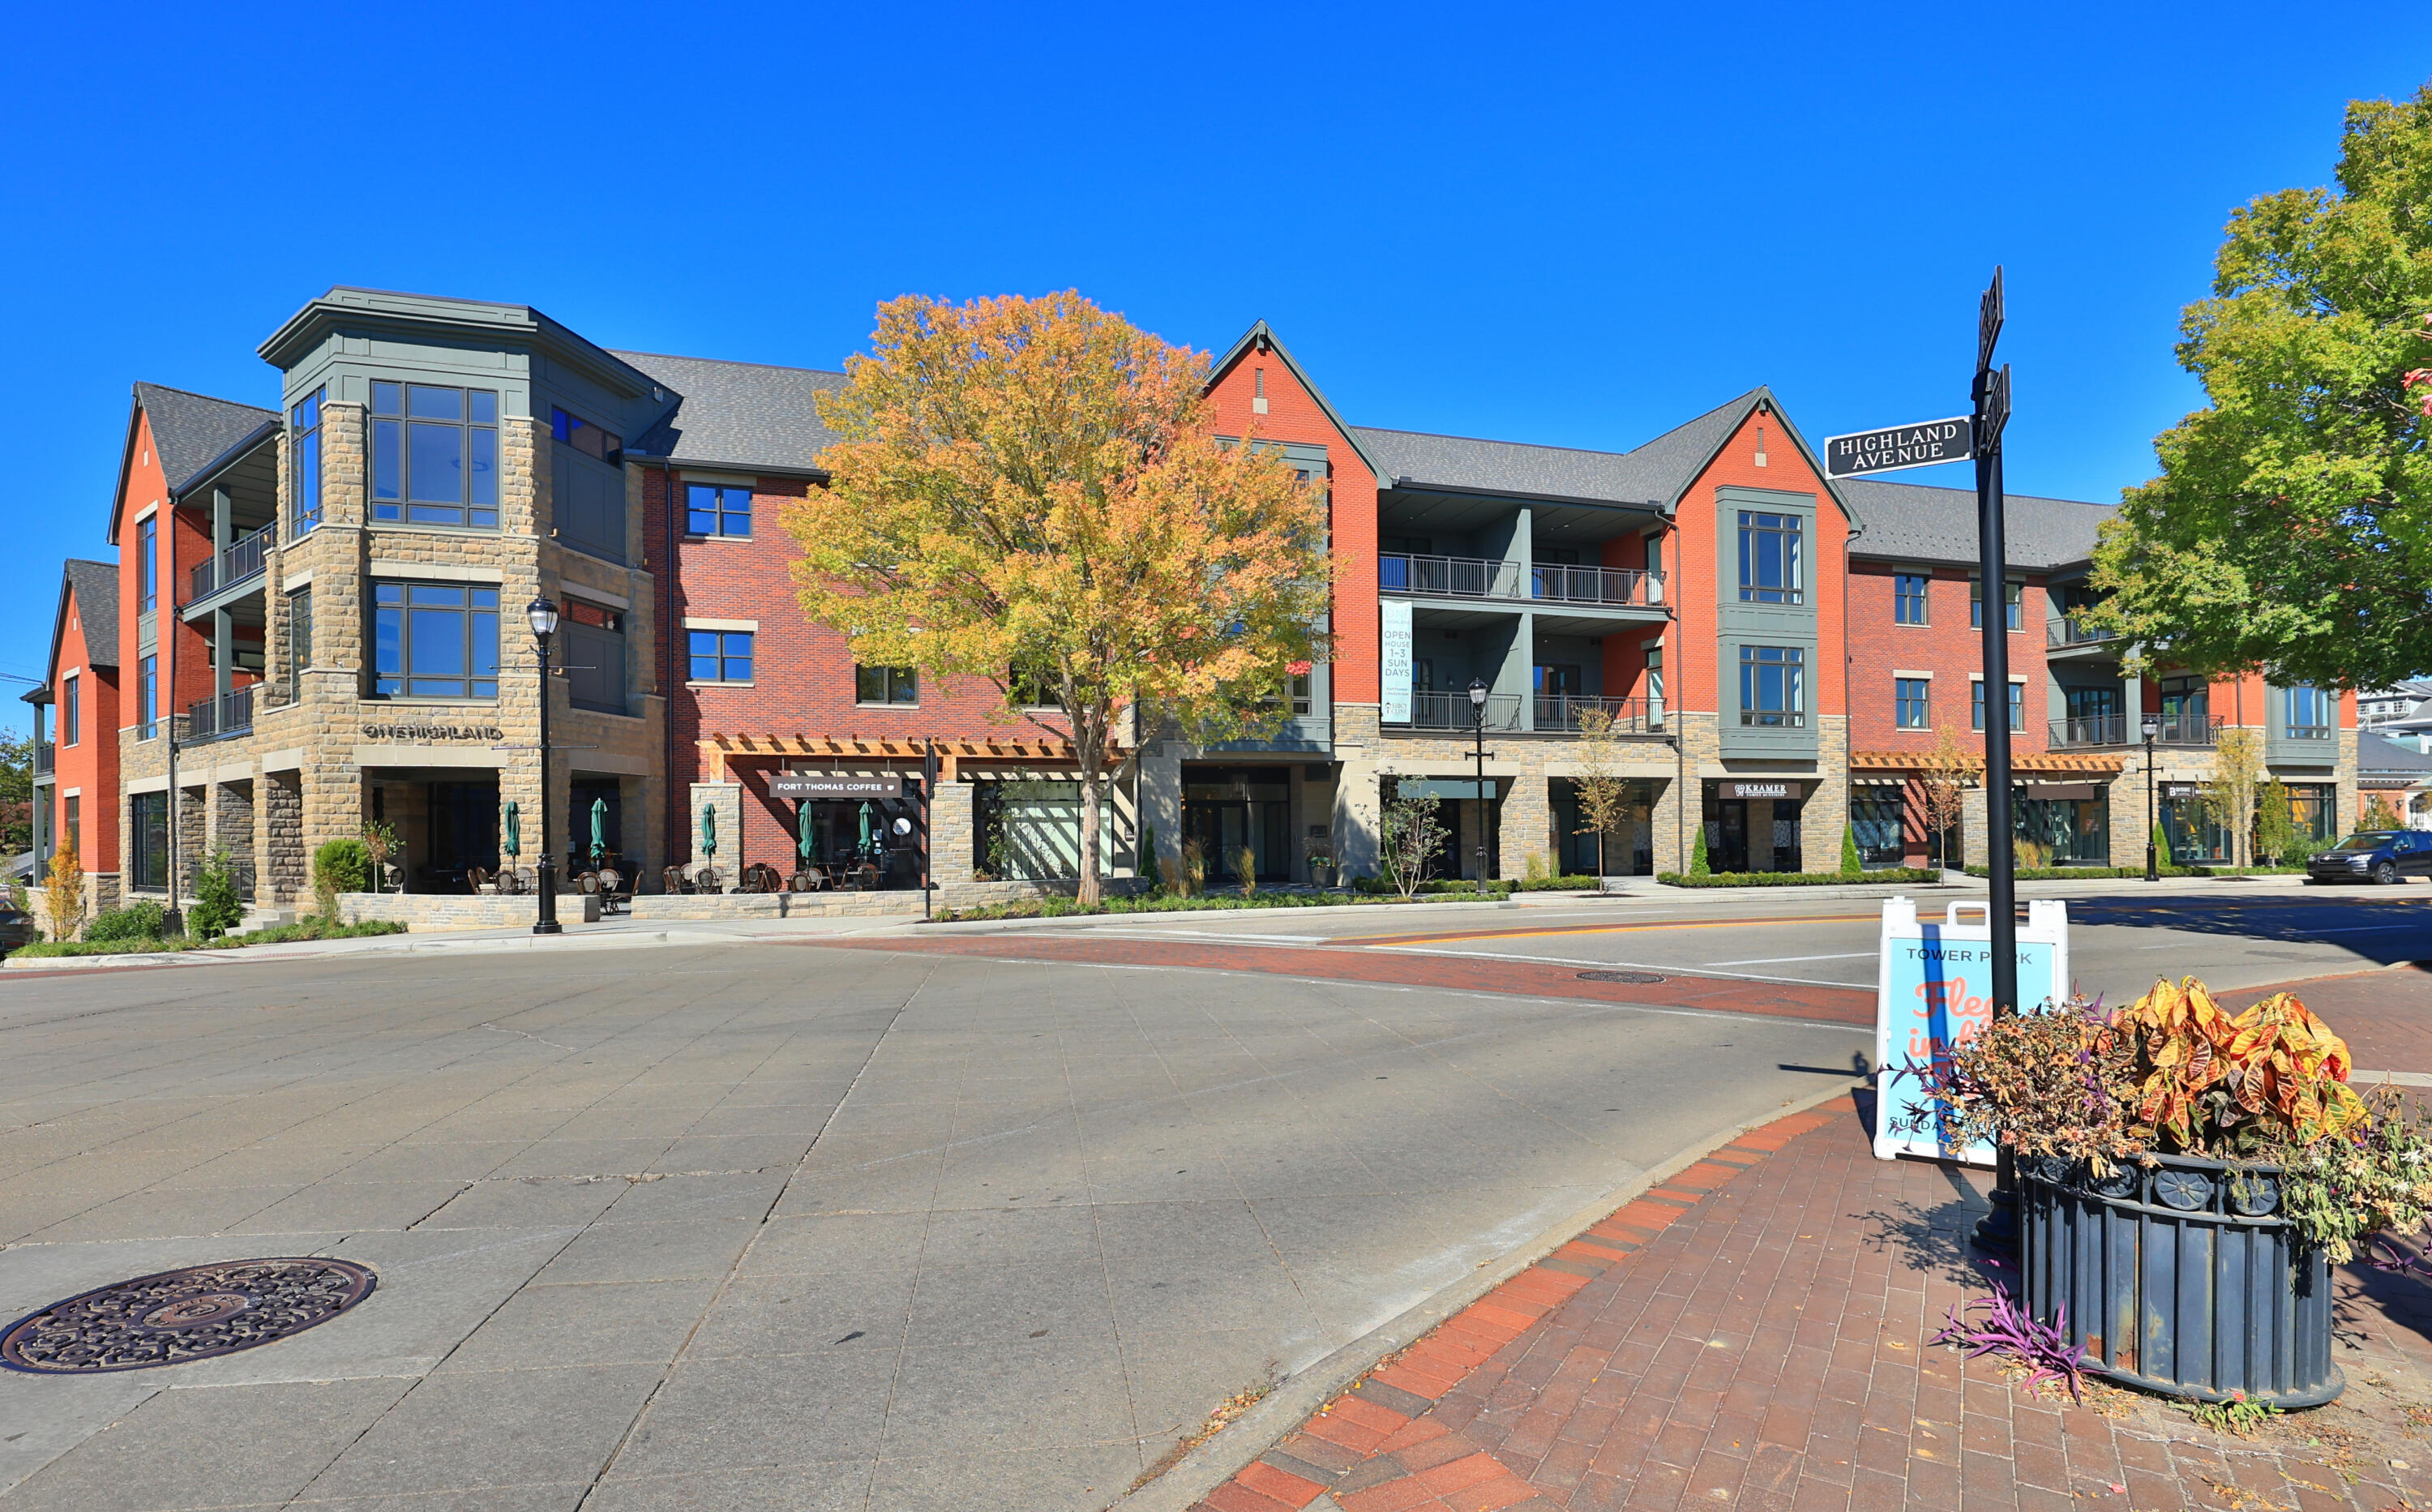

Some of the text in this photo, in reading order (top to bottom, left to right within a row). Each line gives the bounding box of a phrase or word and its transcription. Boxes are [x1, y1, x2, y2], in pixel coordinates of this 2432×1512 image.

[1839, 424, 1957, 456] HIGHLAND
[1852, 442, 1944, 469] AVENUE
[1384, 631, 1411, 639] OPEN
[1387, 659, 1407, 667] SUN
[1385, 669, 1411, 677] DAYS
[777, 782, 802, 790] FORT
[846, 783, 882, 791] COFFEE
[1745, 784, 1786, 792] KRAMER
[1906, 948, 2032, 965] TOWER PK
[1912, 976, 1994, 1019] Fle
[1890, 1116, 1946, 1132] SUNDA
